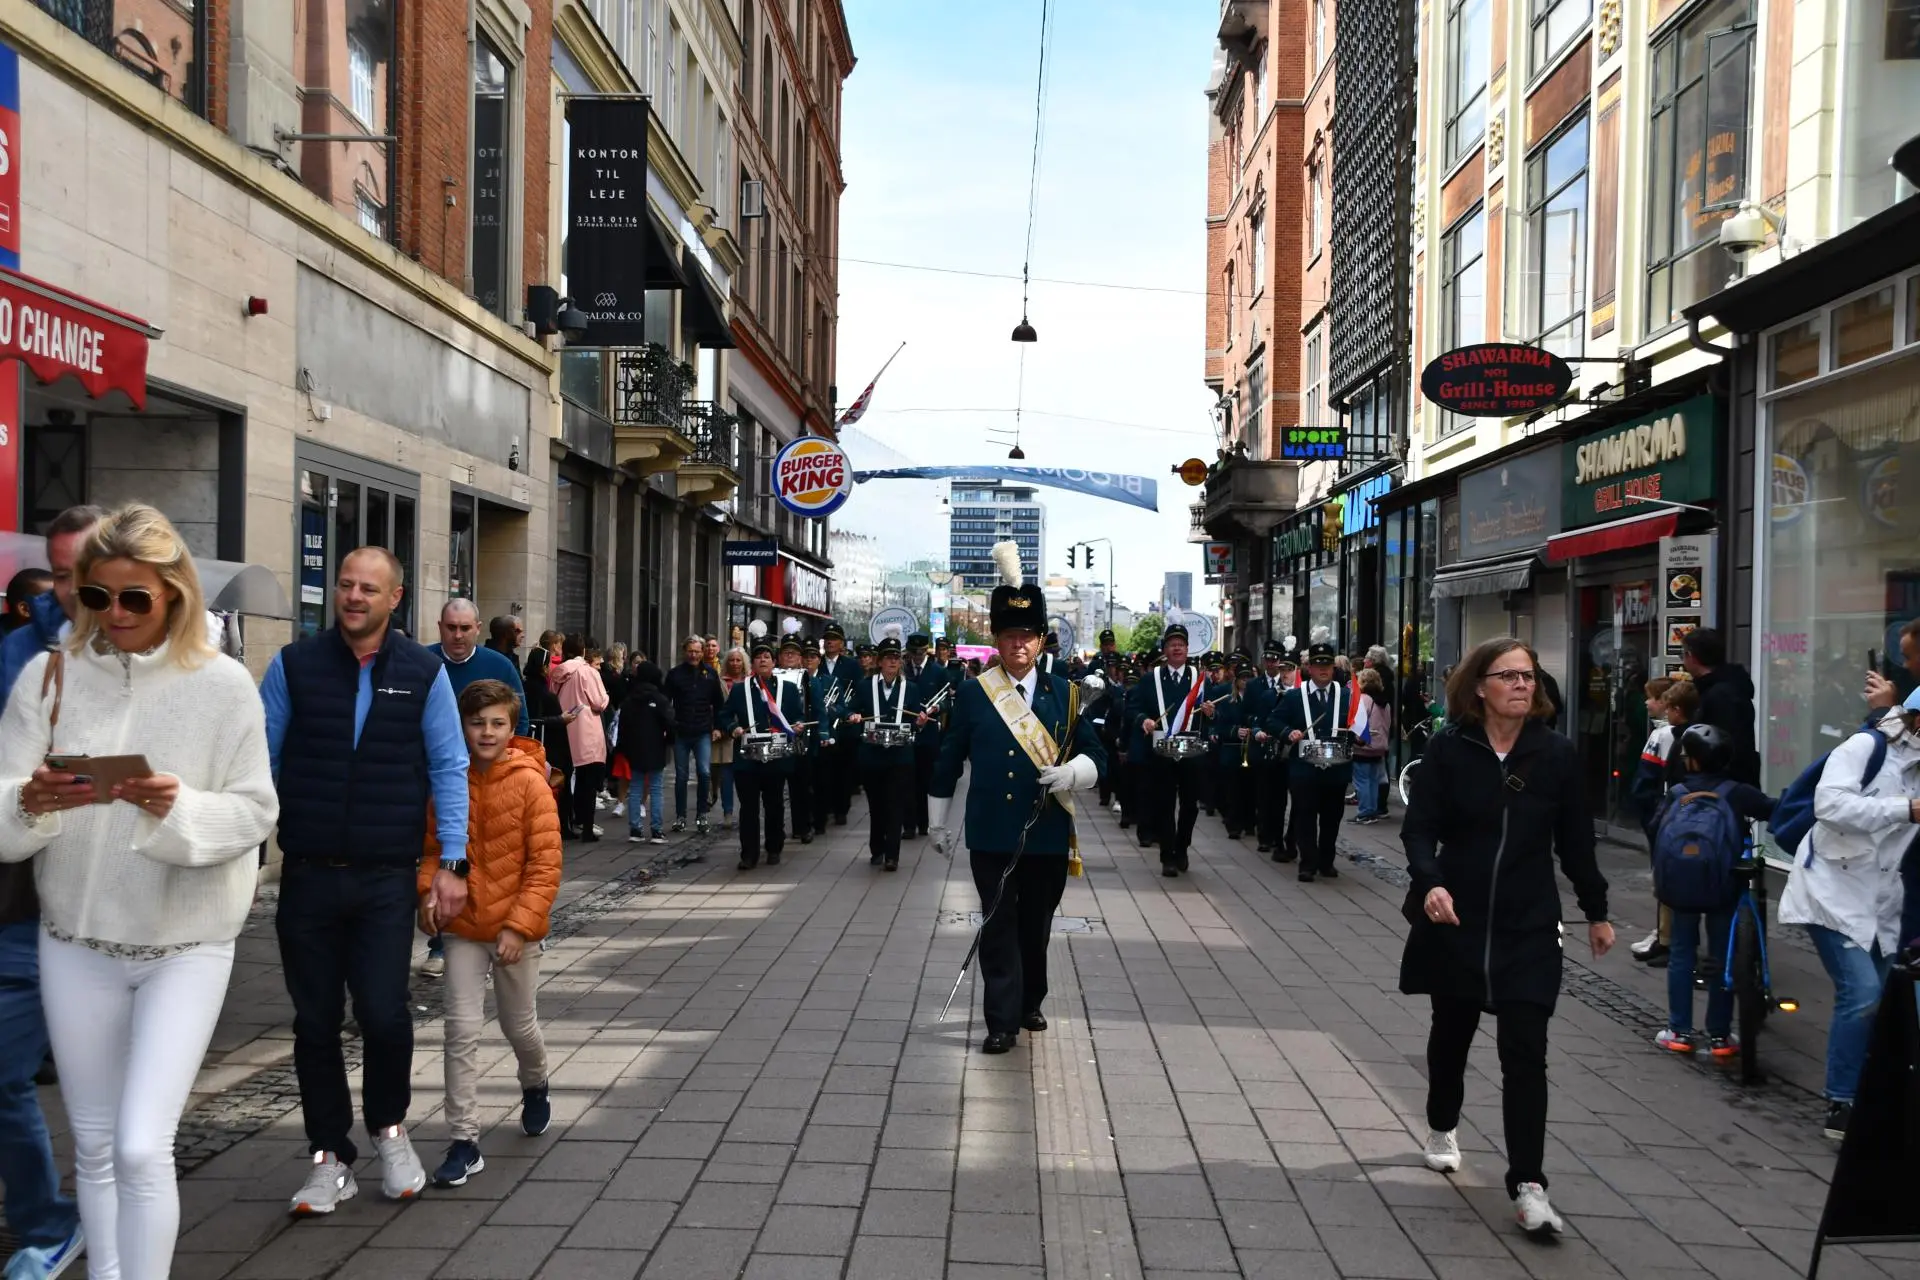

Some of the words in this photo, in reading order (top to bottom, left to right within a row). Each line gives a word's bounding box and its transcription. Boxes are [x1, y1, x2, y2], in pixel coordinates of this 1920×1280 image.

[578, 149, 638, 159] KONTOR
[596, 169, 619, 179] TIL
[590, 189, 625, 199] LEJE
[577, 215, 604, 223] 3315
[610, 215, 637, 223] 0116
[627, 311, 642, 320] CO
[19, 304, 105, 374] CHANGE
[1441, 347, 1552, 371] SHAWARMA
[1439, 380, 1557, 399] Grill-House
[1460, 401, 1498, 410] SINCE
[1288, 430, 1340, 444] SPORT
[1283, 443, 1345, 457] MASTER
[1575, 412, 1687, 485] SHAWARMA
[781, 454, 843, 476] BURGER
[781, 467, 844, 497] KING
[1594, 481, 1623, 513] GRILL
[1624, 472, 1662, 507] HOUSE
